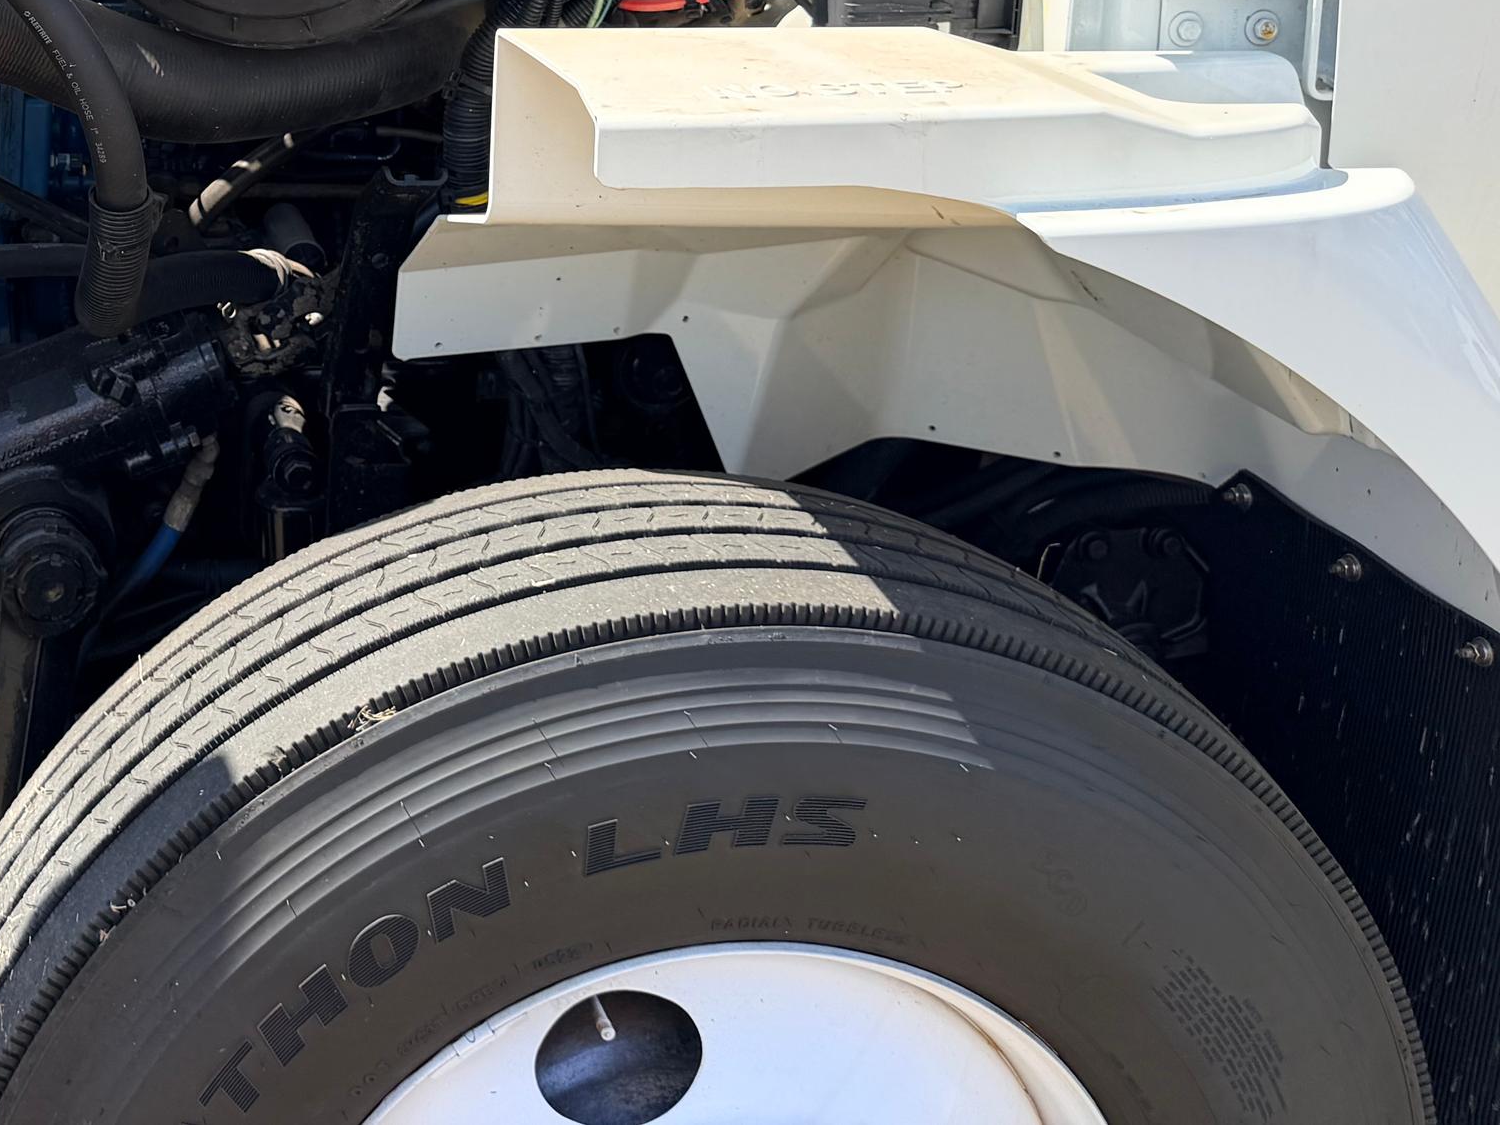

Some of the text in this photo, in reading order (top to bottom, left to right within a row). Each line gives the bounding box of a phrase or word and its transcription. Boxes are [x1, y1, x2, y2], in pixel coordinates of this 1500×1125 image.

[28, 16, 53, 45] FLEETRITE
[52, 49, 67, 71] FUEL
[71, 81, 81, 96] OIL
[79, 97, 95, 121] HOSE
[814, 80, 964, 97] STEP
[197, 856, 512, 1118] THON
[583, 796, 867, 876] LHS
